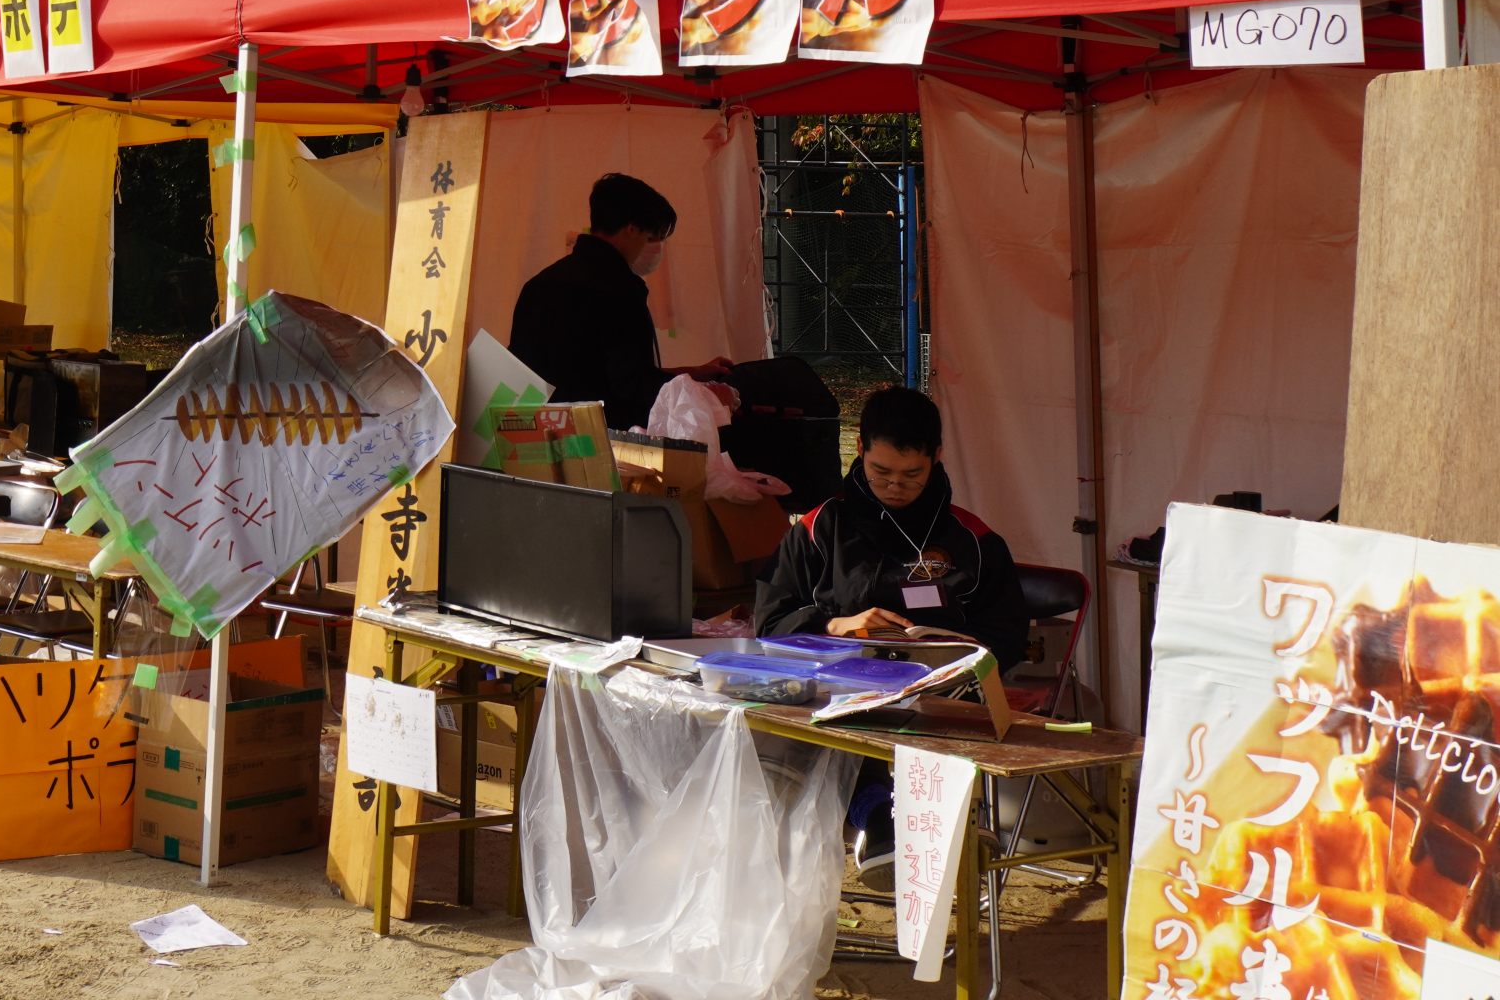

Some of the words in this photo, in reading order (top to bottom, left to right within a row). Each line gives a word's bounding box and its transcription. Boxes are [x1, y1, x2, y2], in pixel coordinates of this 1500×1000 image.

[1200, 7, 1349, 48] MG-070
[419, 161, 454, 280] 体育会
[476, 762, 502, 779] azon
[1368, 689, 1500, 796] Delicio
